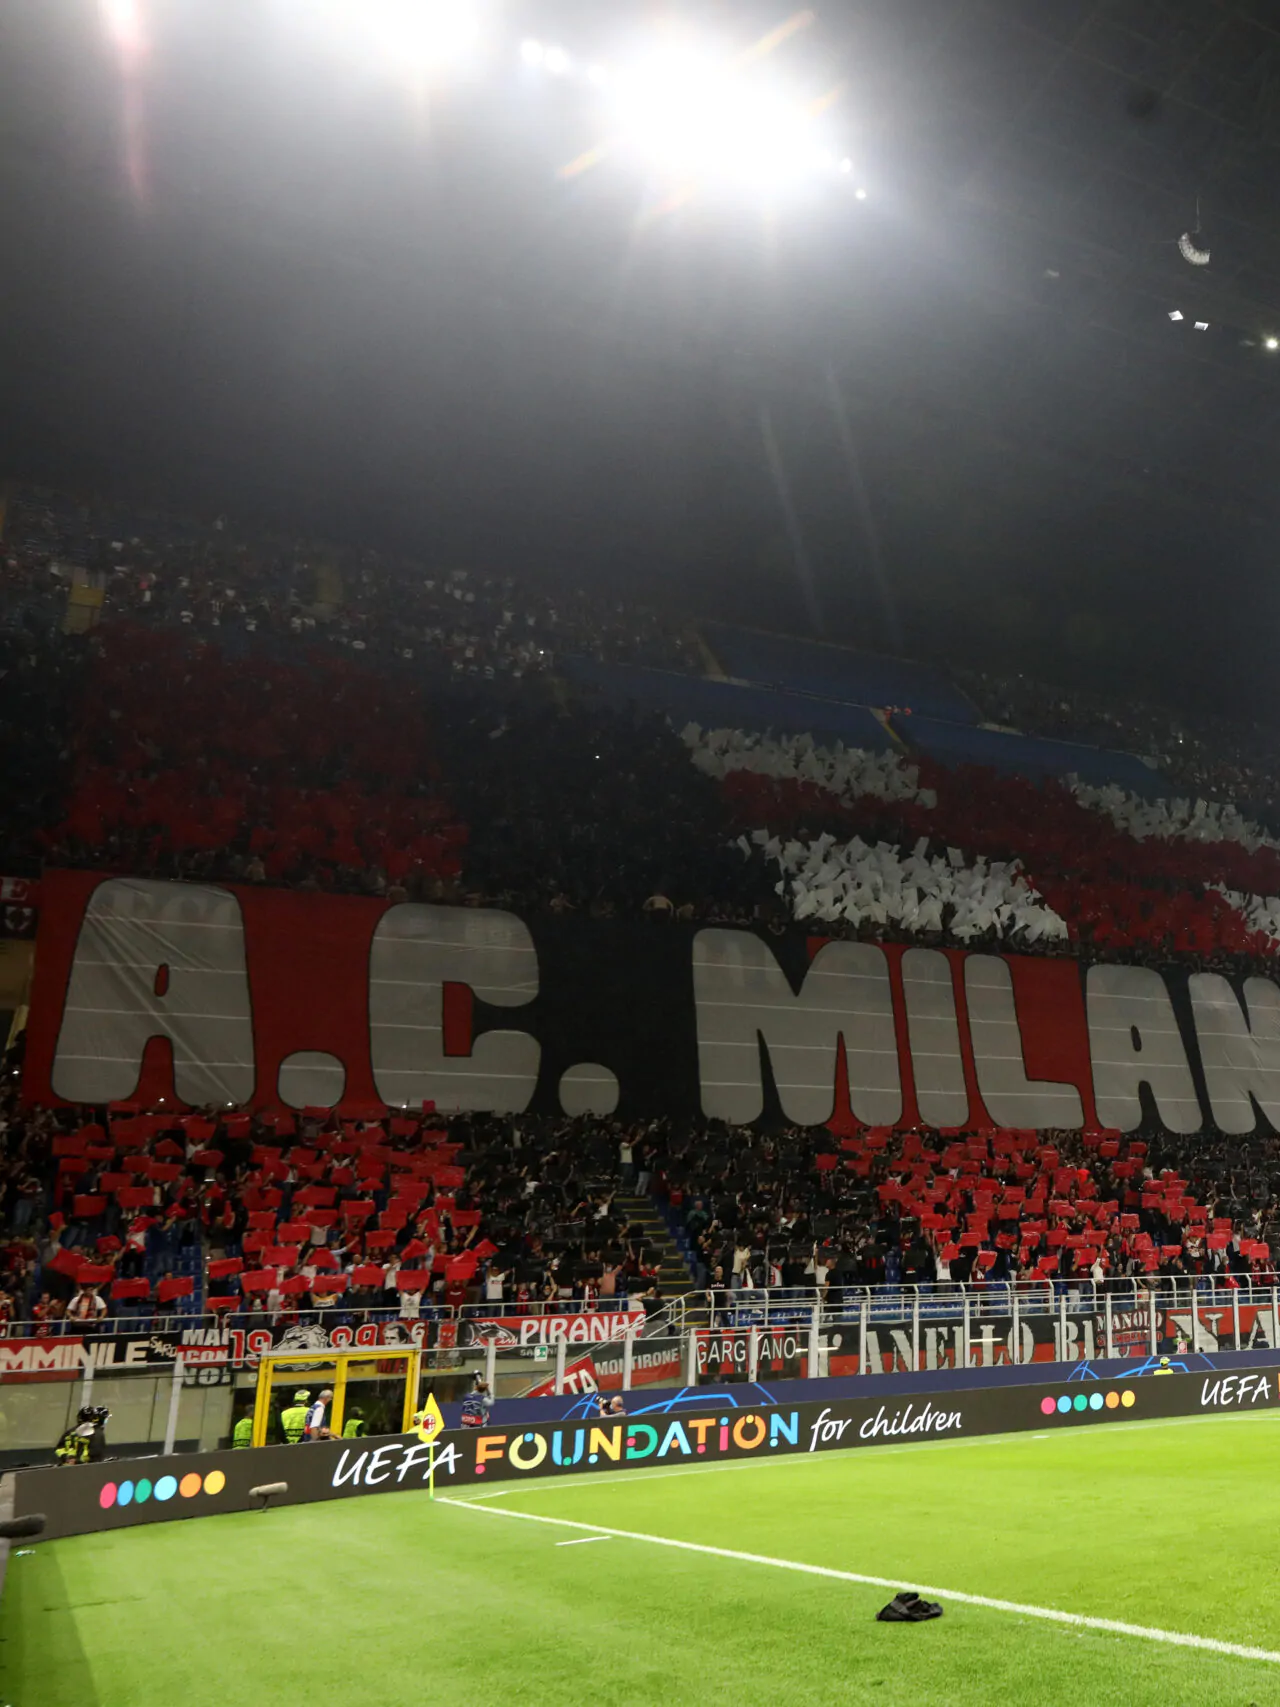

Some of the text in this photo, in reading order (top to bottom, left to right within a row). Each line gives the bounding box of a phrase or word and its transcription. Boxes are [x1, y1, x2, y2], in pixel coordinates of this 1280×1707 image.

[696, 1336, 796, 1364] GARGANO
[1201, 1375, 1269, 1406] UEFA
[333, 1401, 962, 1487] UEFA FOUNDATION for children
